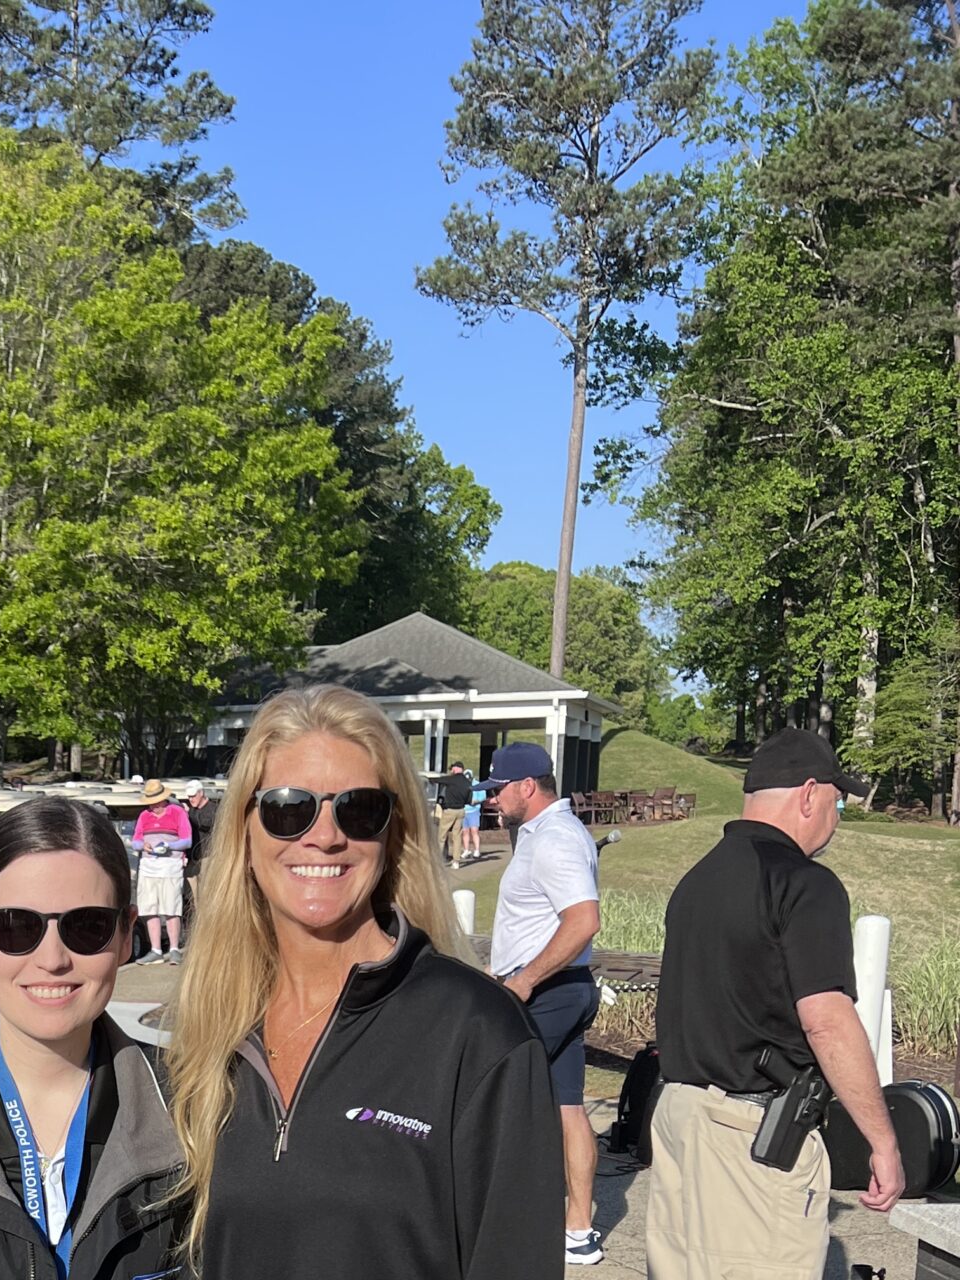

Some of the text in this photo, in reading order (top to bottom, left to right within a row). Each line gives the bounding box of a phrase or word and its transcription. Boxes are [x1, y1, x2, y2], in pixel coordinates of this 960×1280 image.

[376, 1109, 432, 1134] innovative
[6, 1100, 40, 1219] ACWORTH POLICE
